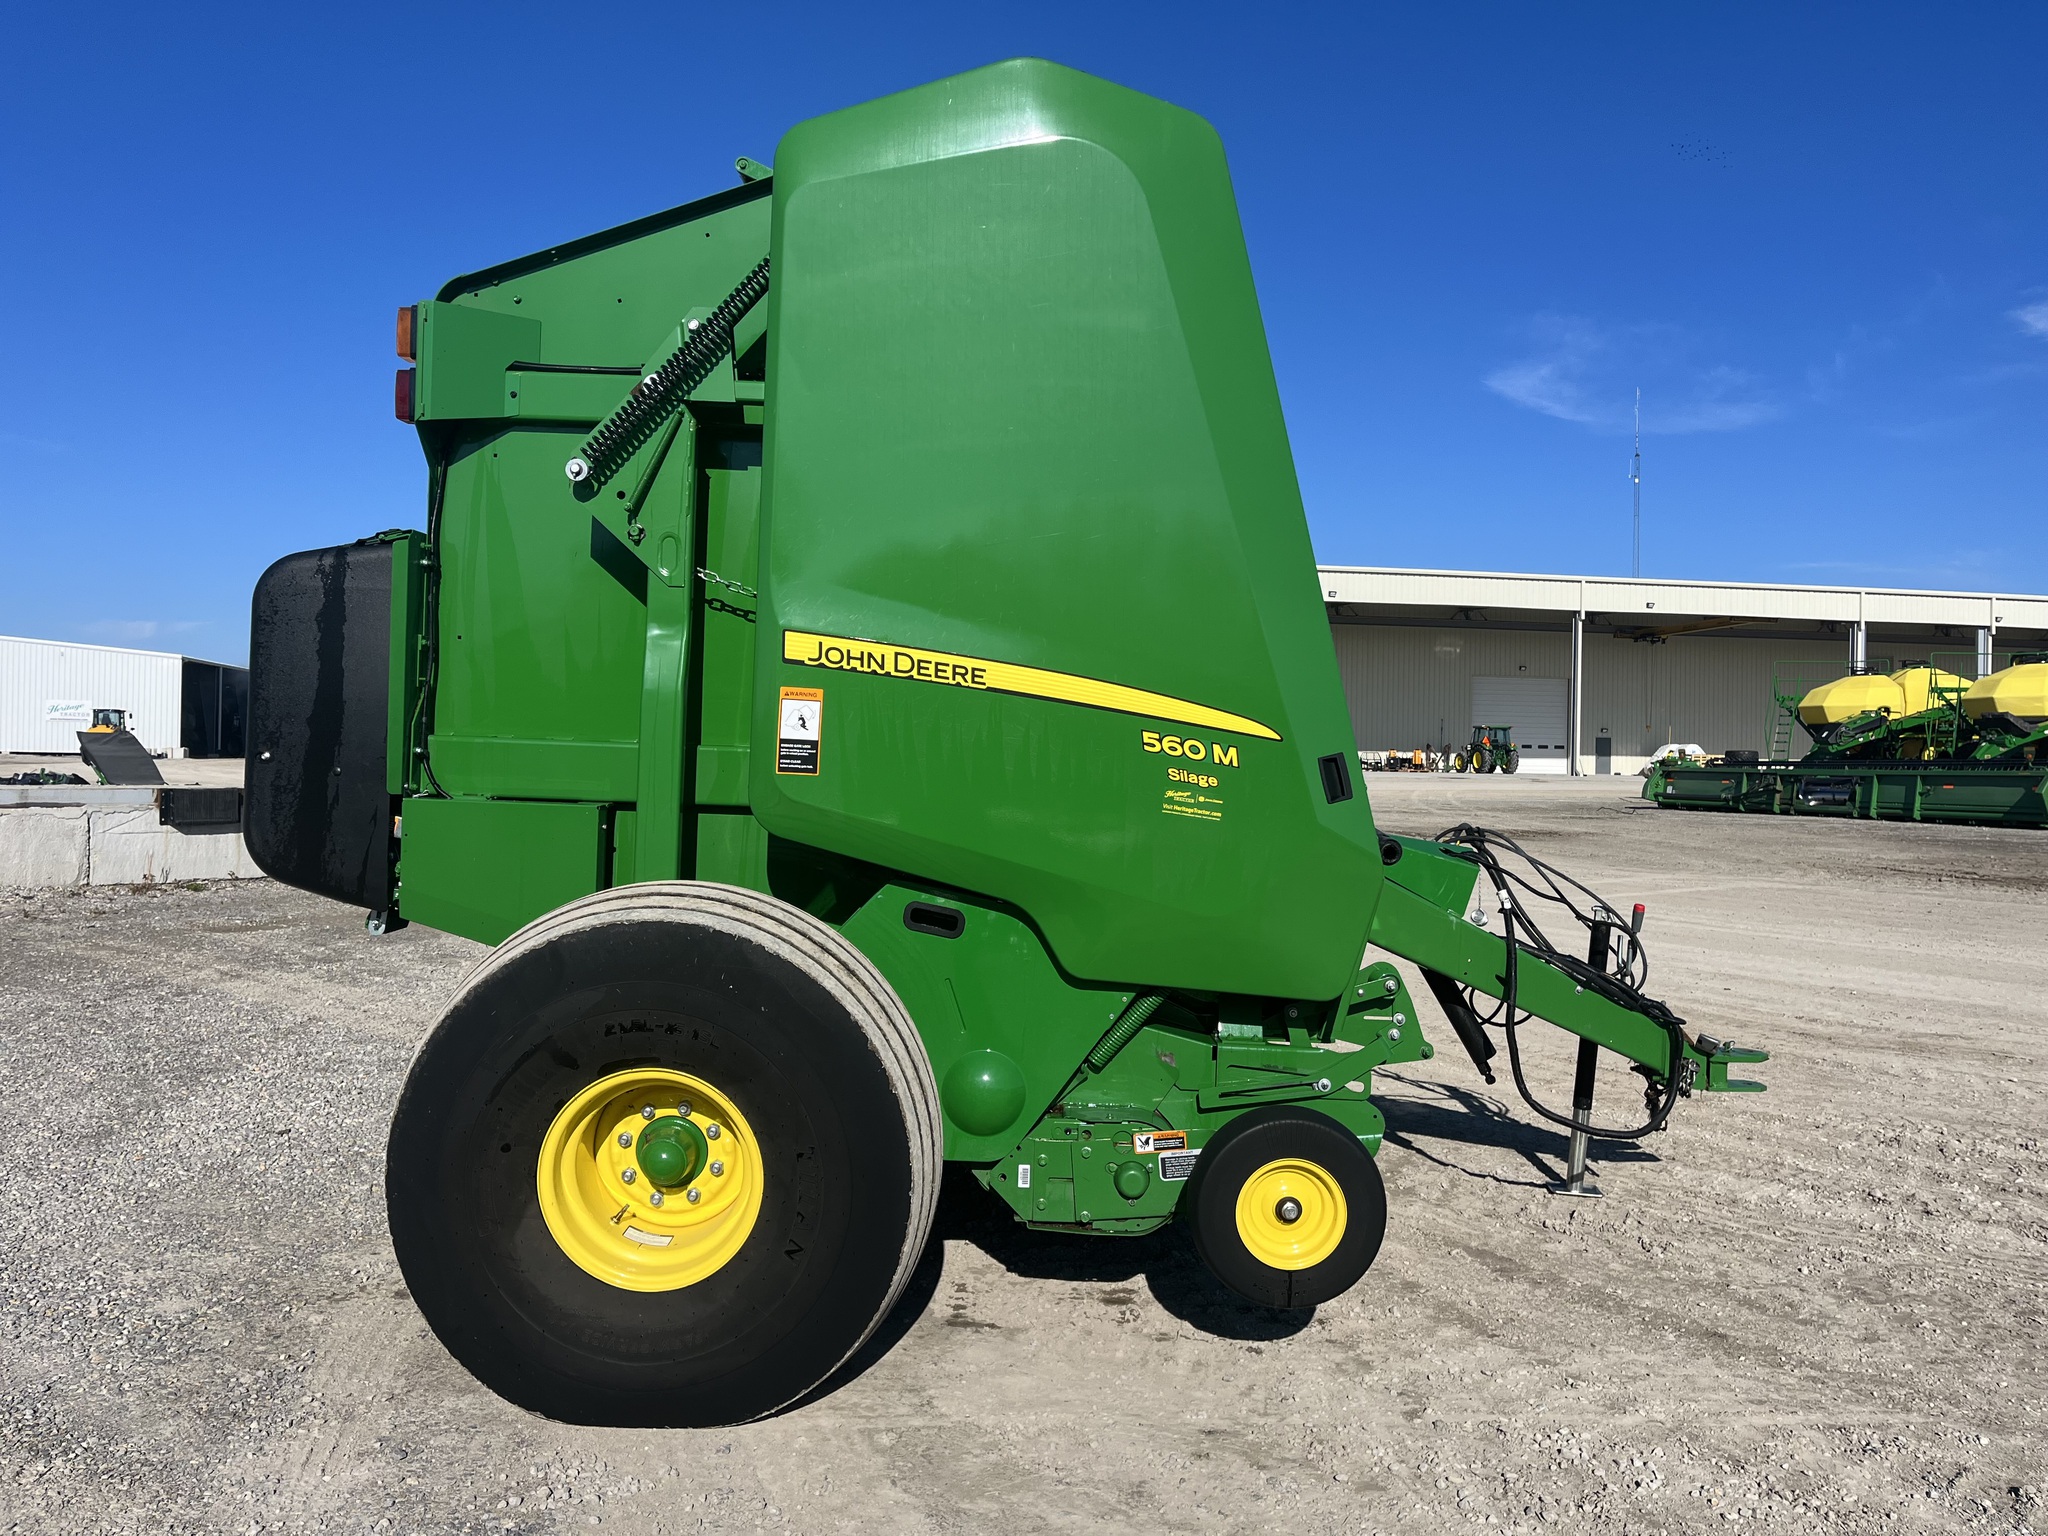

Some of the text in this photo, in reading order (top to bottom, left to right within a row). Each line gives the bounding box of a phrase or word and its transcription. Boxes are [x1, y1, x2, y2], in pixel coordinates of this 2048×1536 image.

[807, 641, 987, 687] JOHN DEERE
[47, 703, 85, 714] Heritage
[1141, 730, 1240, 769] 560 M
[1167, 767, 1219, 788] Silage
